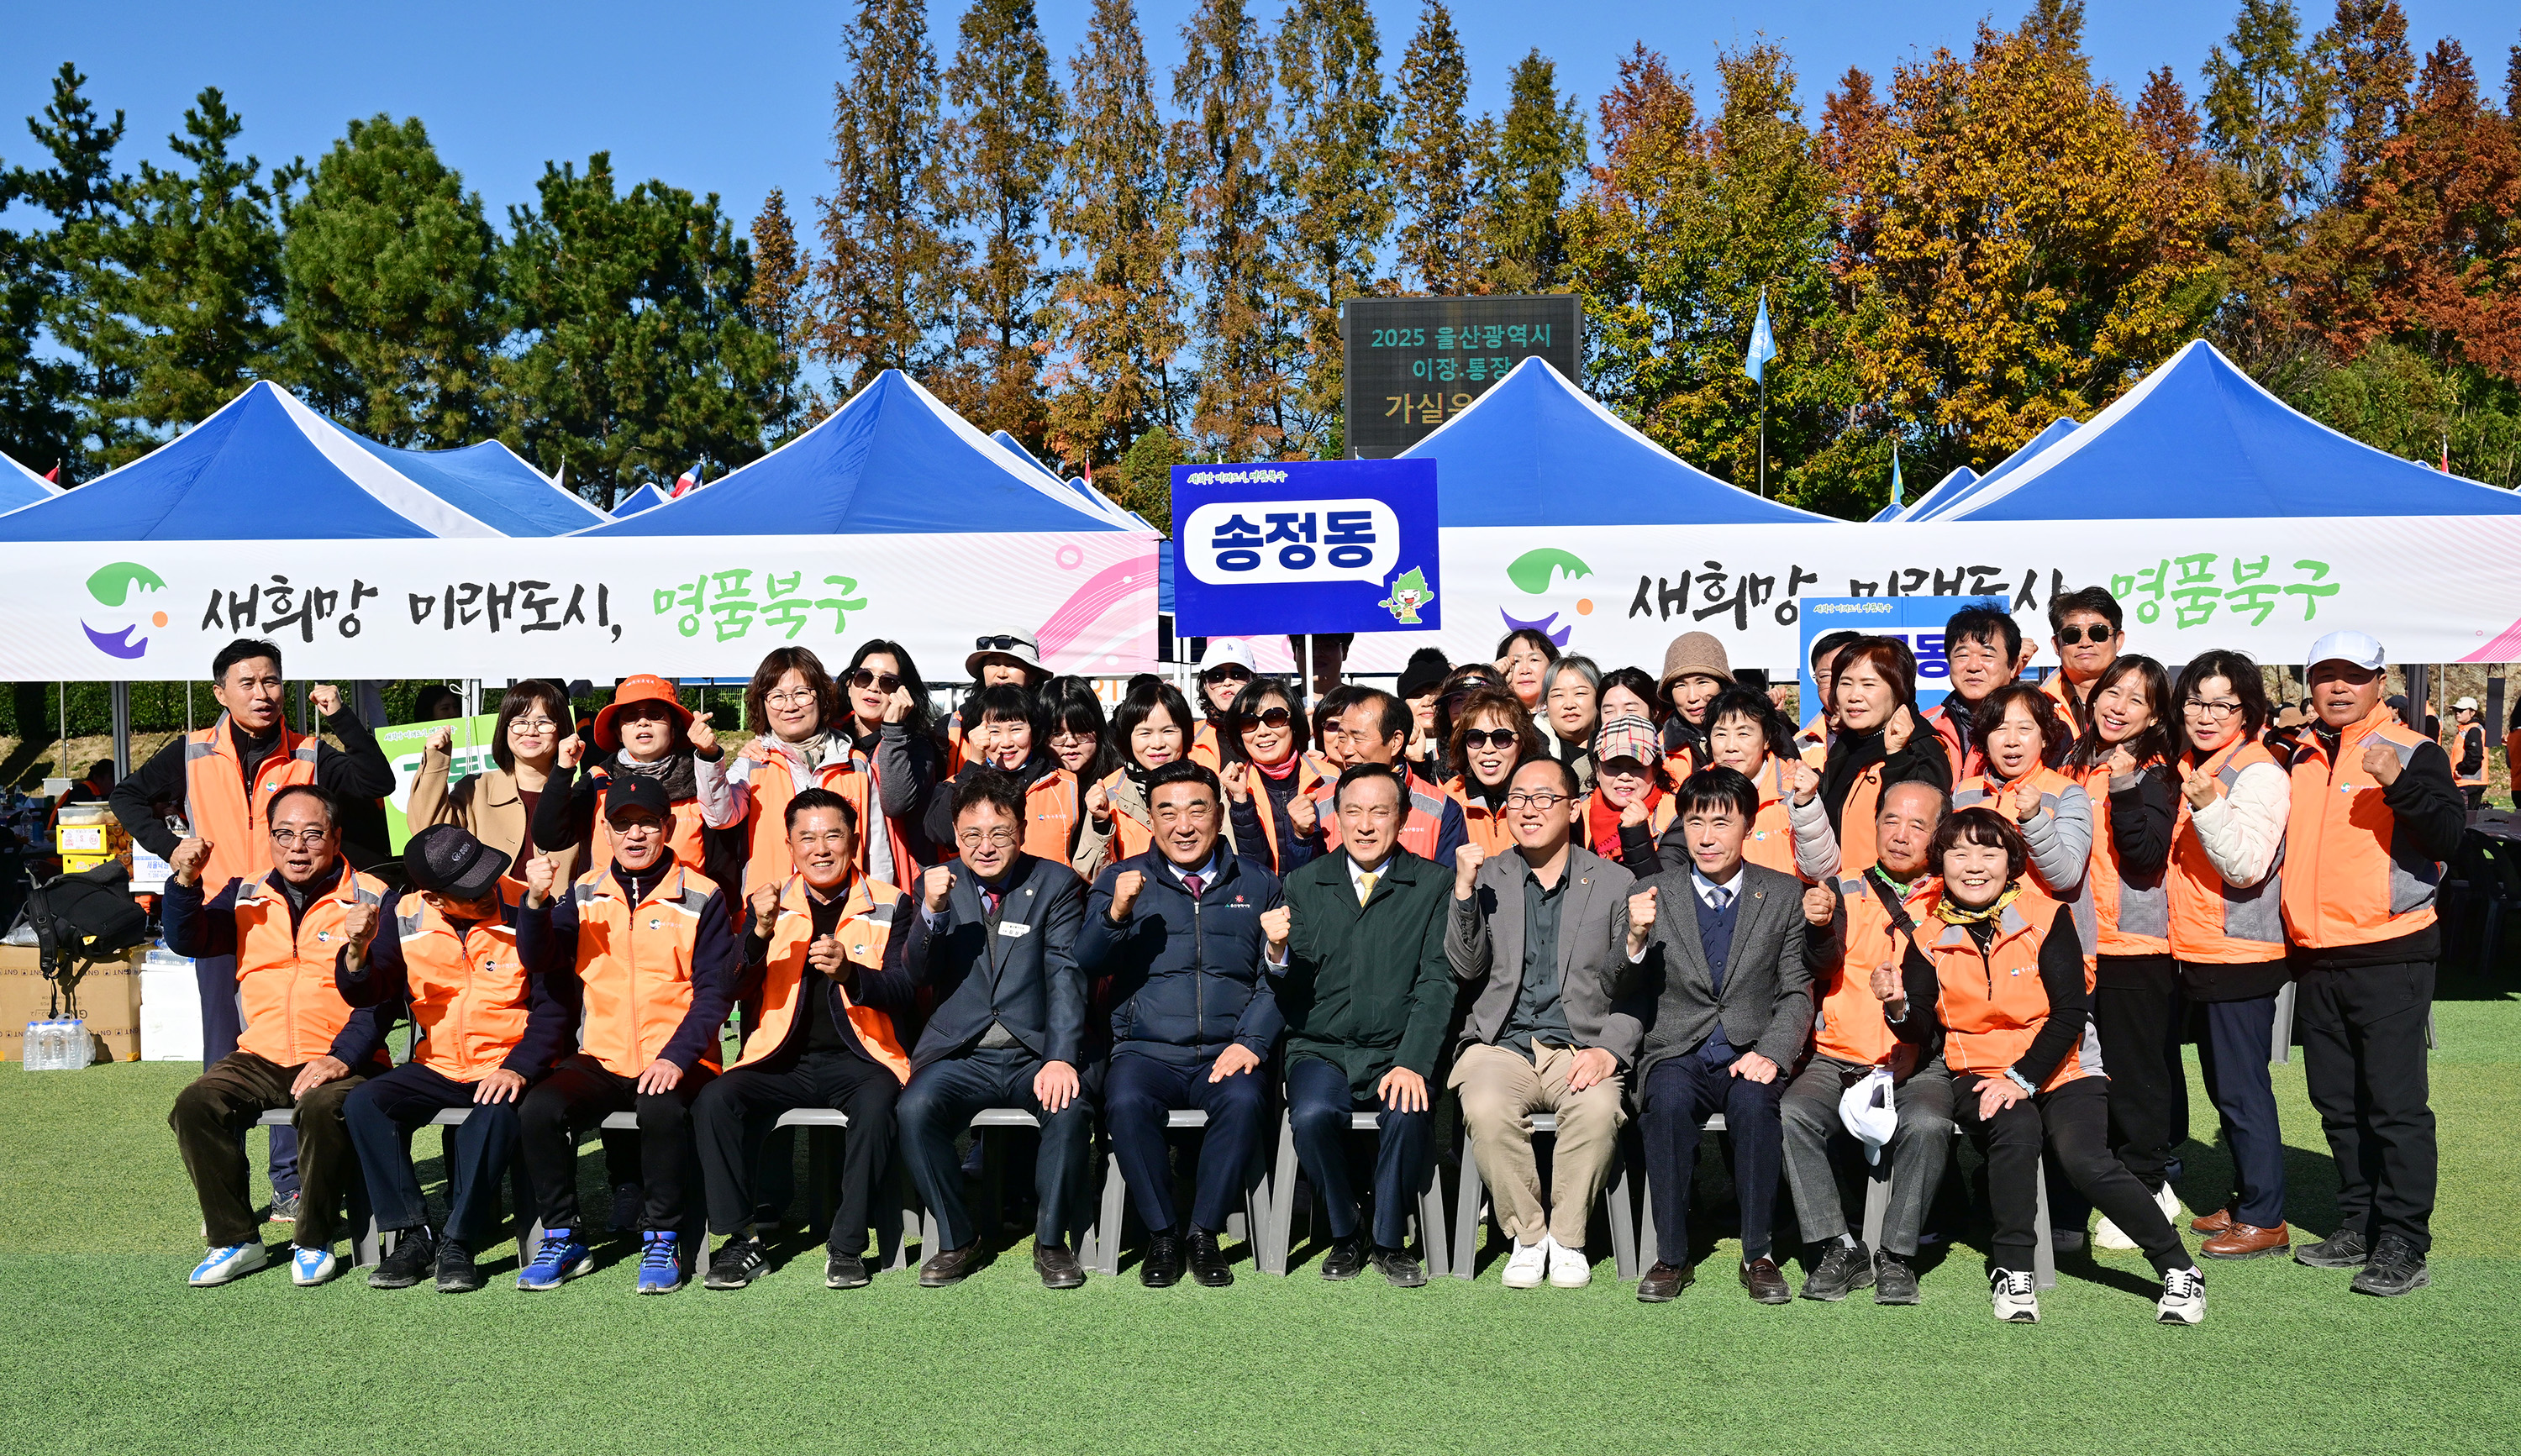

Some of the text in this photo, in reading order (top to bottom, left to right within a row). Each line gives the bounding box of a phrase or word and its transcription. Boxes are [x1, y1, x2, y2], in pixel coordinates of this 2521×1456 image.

[1371, 323, 1550, 350] 2025 울산광역시
[1187, 471, 1214, 485] 새희망
[1250, 470, 1288, 483] 명품북구
[1213, 511, 1376, 570] 송정동
[203, 568, 868, 644] 새희망 미래도시, 명품북구
[1629, 560, 1818, 631] 새희망
[2110, 552, 2341, 630] 명품북구
[1813, 603, 1835, 614] 새희망
[1862, 602, 1893, 613] 명품북구
